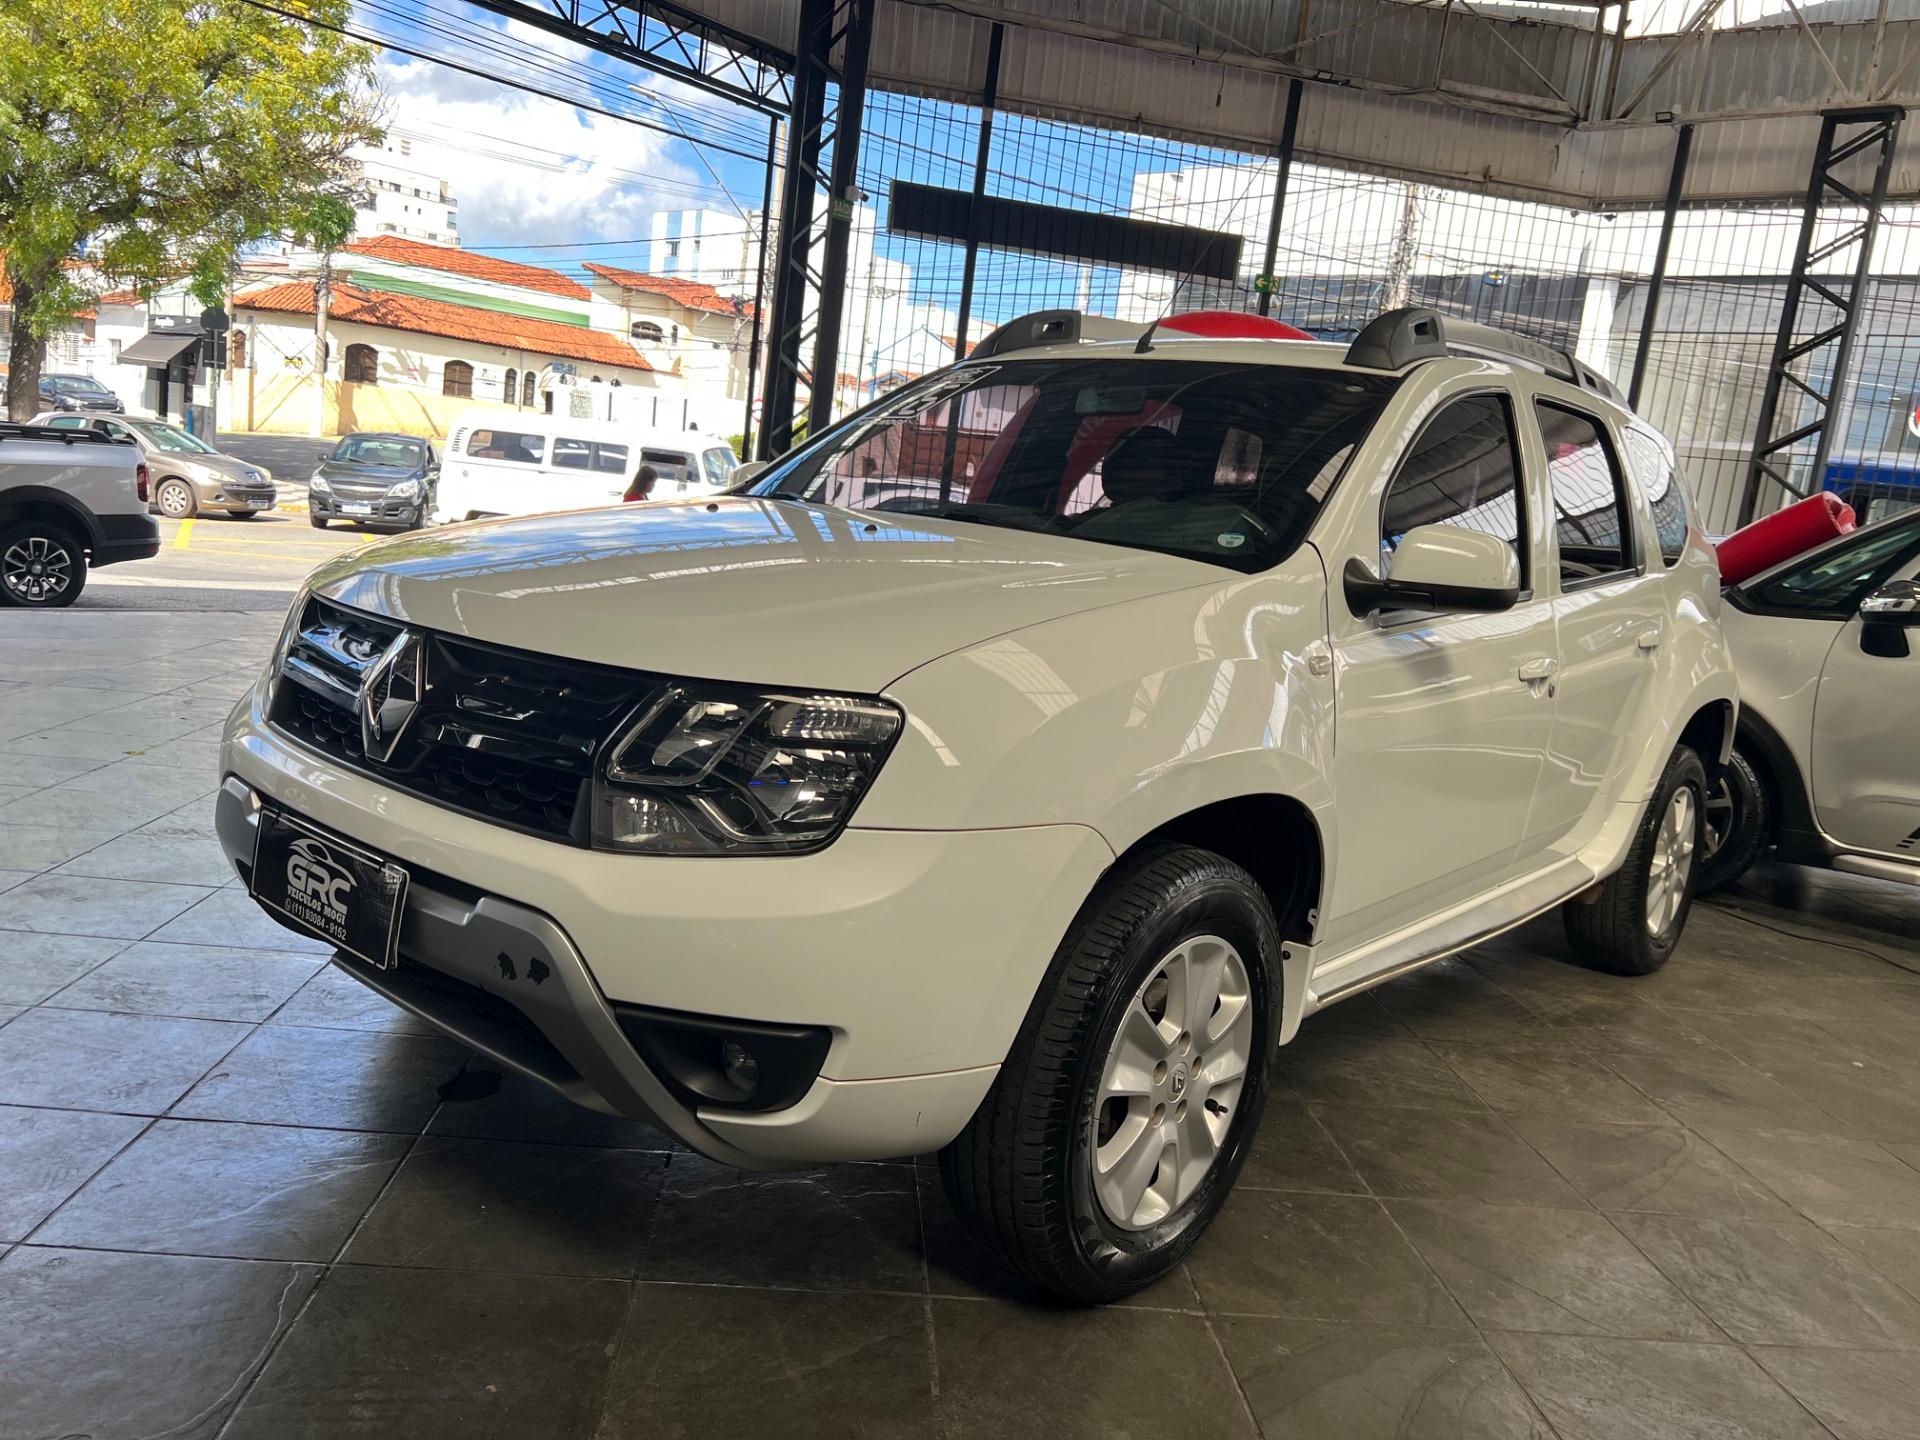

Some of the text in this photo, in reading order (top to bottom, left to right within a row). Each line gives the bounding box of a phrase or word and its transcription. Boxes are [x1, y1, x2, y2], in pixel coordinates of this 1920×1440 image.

[287, 854, 351, 915] GRC
[288, 884, 346, 926] VEICULOS MOGI
[292, 902, 305, 920] (11)
